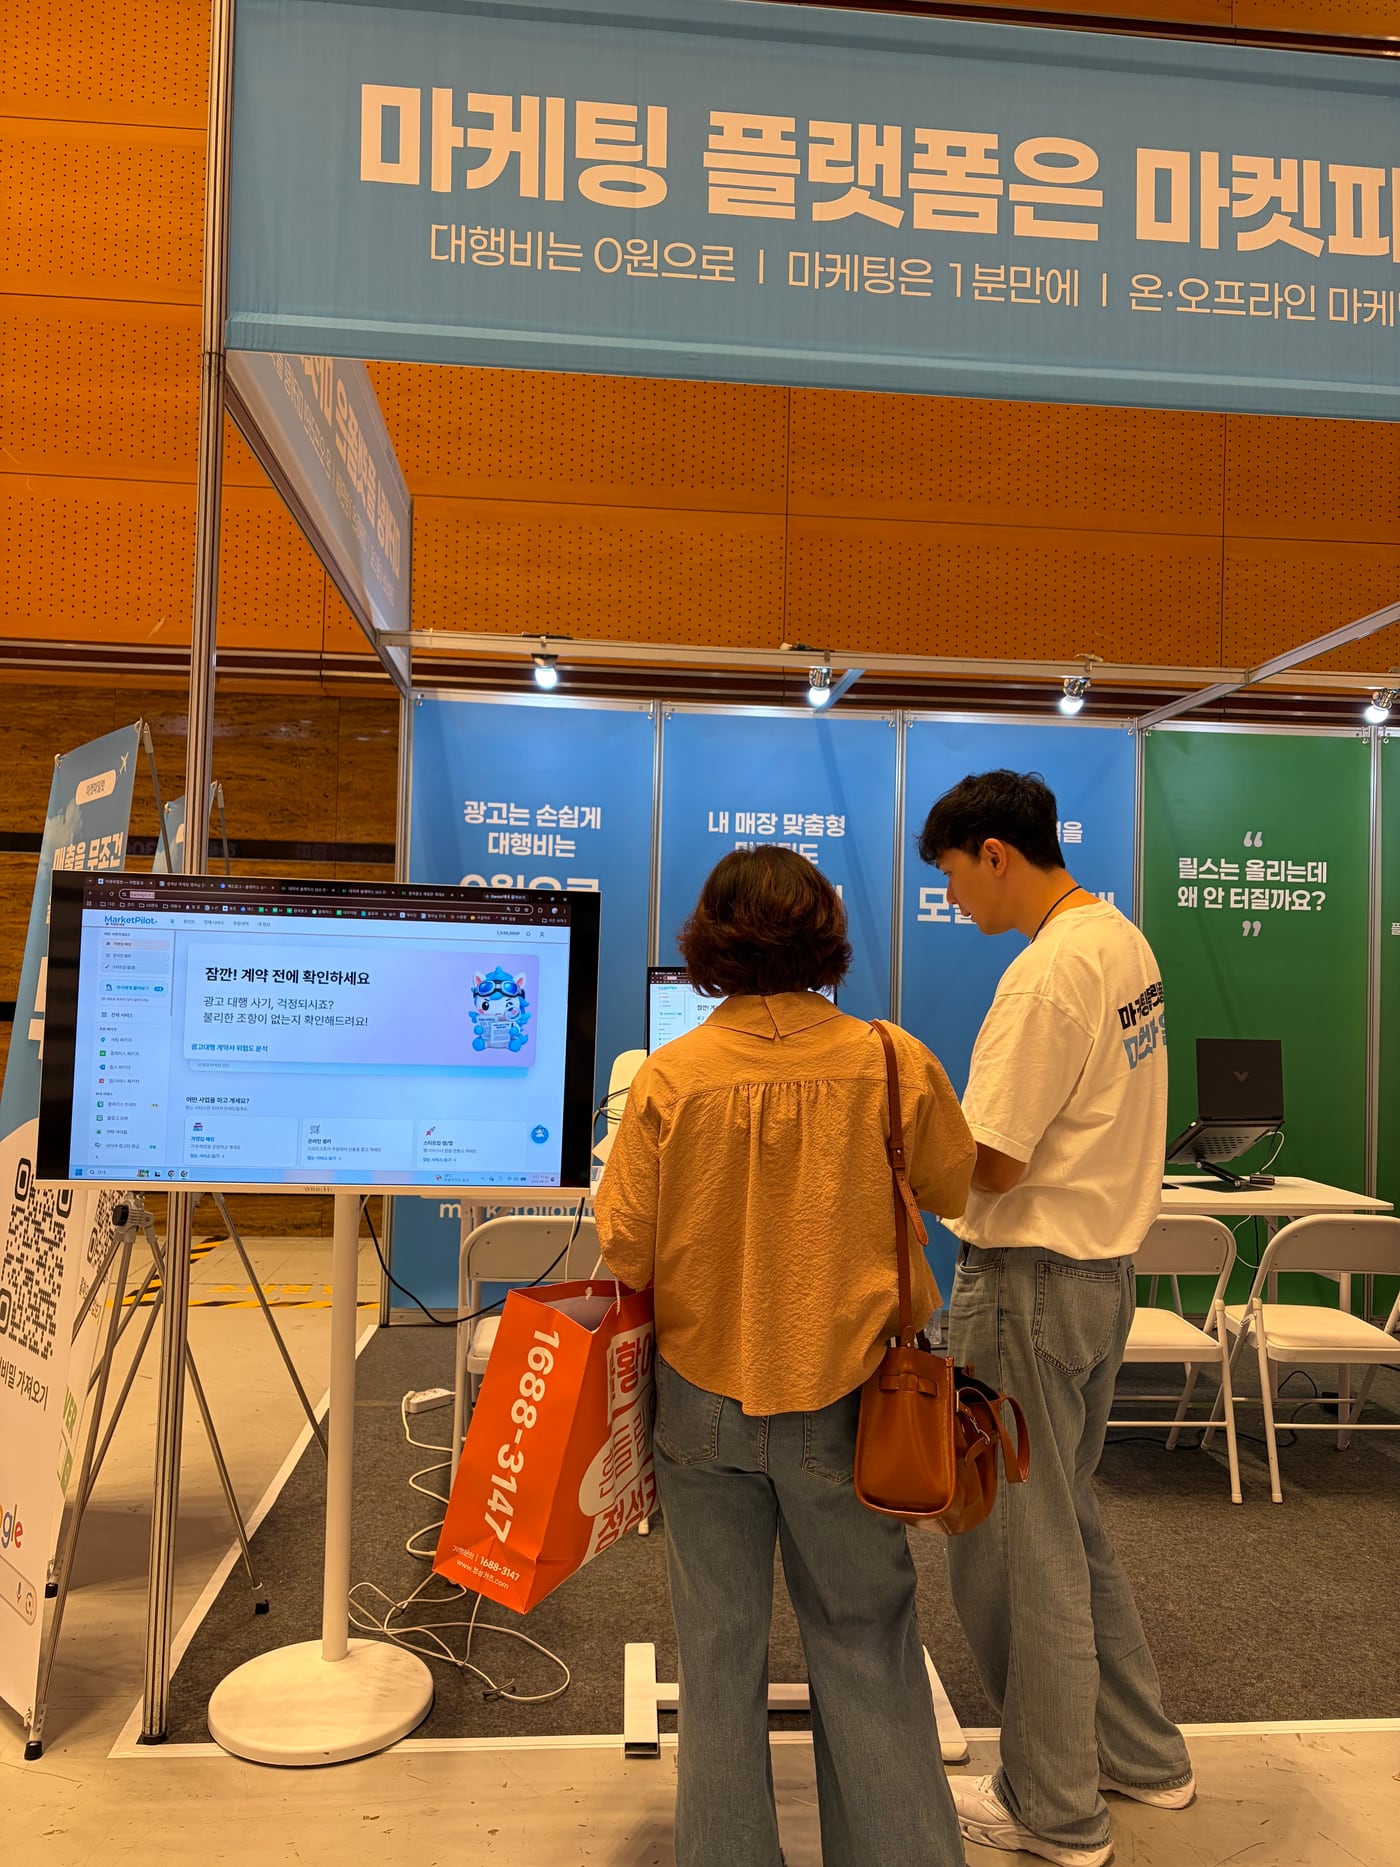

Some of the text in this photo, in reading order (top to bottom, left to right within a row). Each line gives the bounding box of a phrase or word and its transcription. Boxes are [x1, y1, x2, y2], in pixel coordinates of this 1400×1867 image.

[360, 84, 668, 209] 마케팅
[703, 111, 1103, 242] 플랫폼은
[430, 223, 1400, 328] 대행비는 0원으로 마케팅은 1분만에 온·오프라인 마케
[464, 801, 601, 830] 광고는 손쉽게
[708, 811, 846, 838] 내 매장 맞춤형
[88, 832, 124, 870] 무조건
[487, 833, 576, 859] 대행비는
[1177, 857, 1327, 884] 릴스는 올리는데
[1177, 887, 1326, 912] 왜 안 터질까요?
[104, 915, 155, 925] MarketPilot
[205, 967, 370, 986] 잠깐! 계약 전에 확인하세요
[203, 996, 334, 1011] 광고 대행 사기, 걱정되시죠?
[202, 1012, 368, 1027] 불리한 조항이 없는지 확인해드려요!
[16, 1370, 49, 1412] 가져오기
[484, 1330, 560, 1543] 1688-3147
[480, 1556, 520, 1582] 1688-3147
